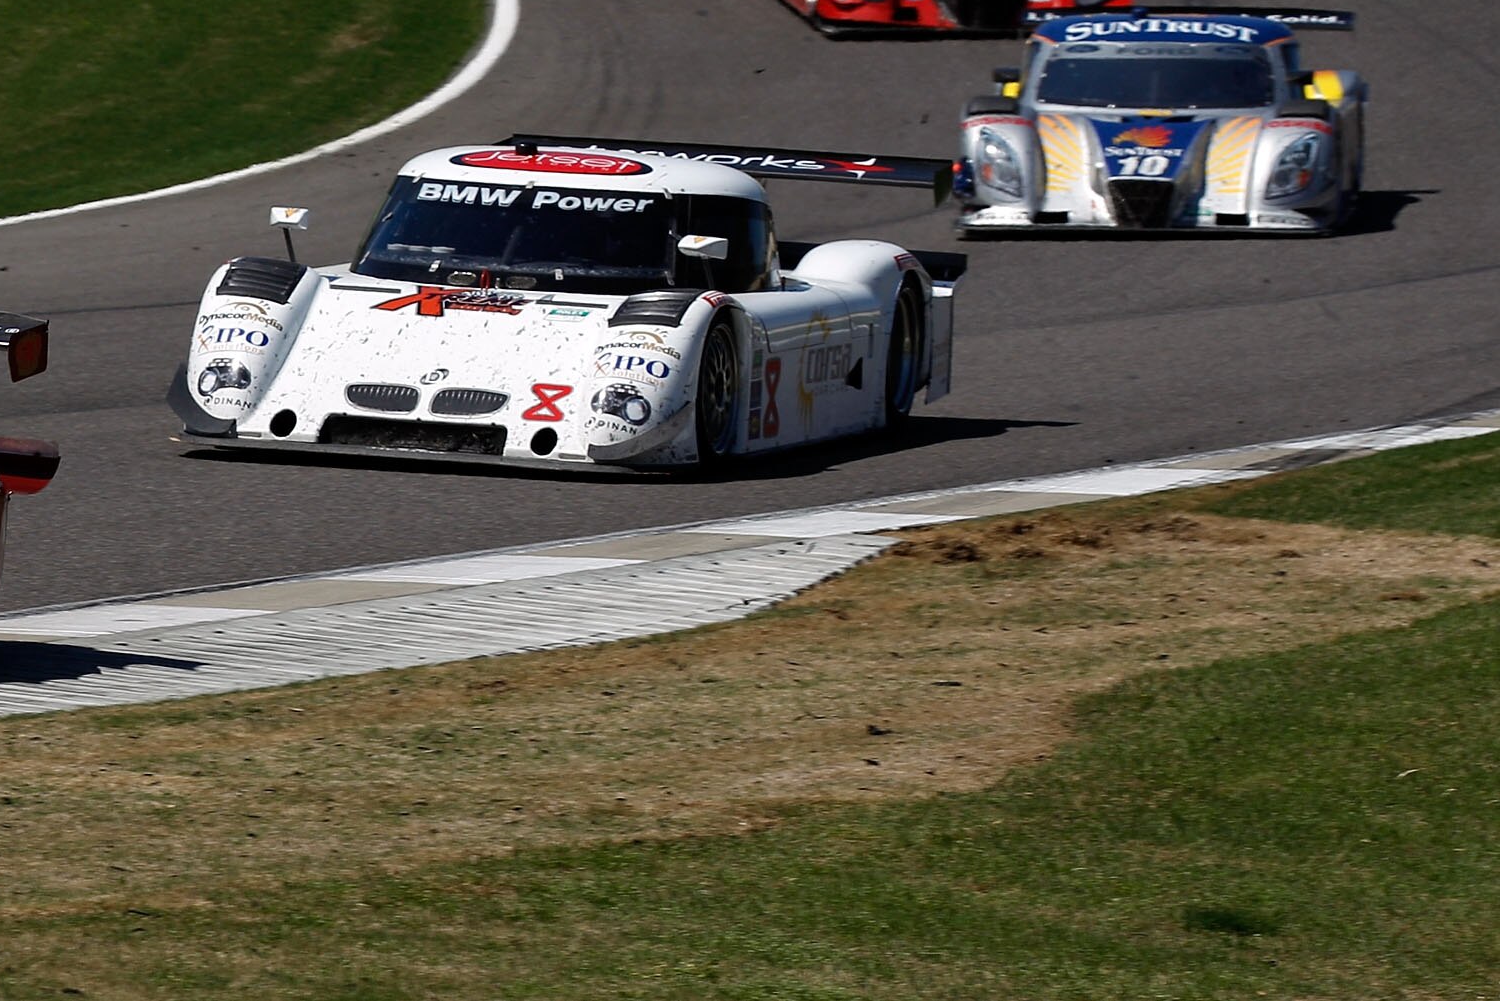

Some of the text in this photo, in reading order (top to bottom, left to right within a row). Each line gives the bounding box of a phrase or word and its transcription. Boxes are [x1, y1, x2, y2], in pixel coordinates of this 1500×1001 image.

[1117, 155, 1170, 176] 10
[417, 182, 655, 213] BMW Power
[215, 327, 270, 347] IPO
[613, 355, 670, 379] IPO
[213, 397, 253, 410] DINAN
[597, 419, 638, 435] DINAN
